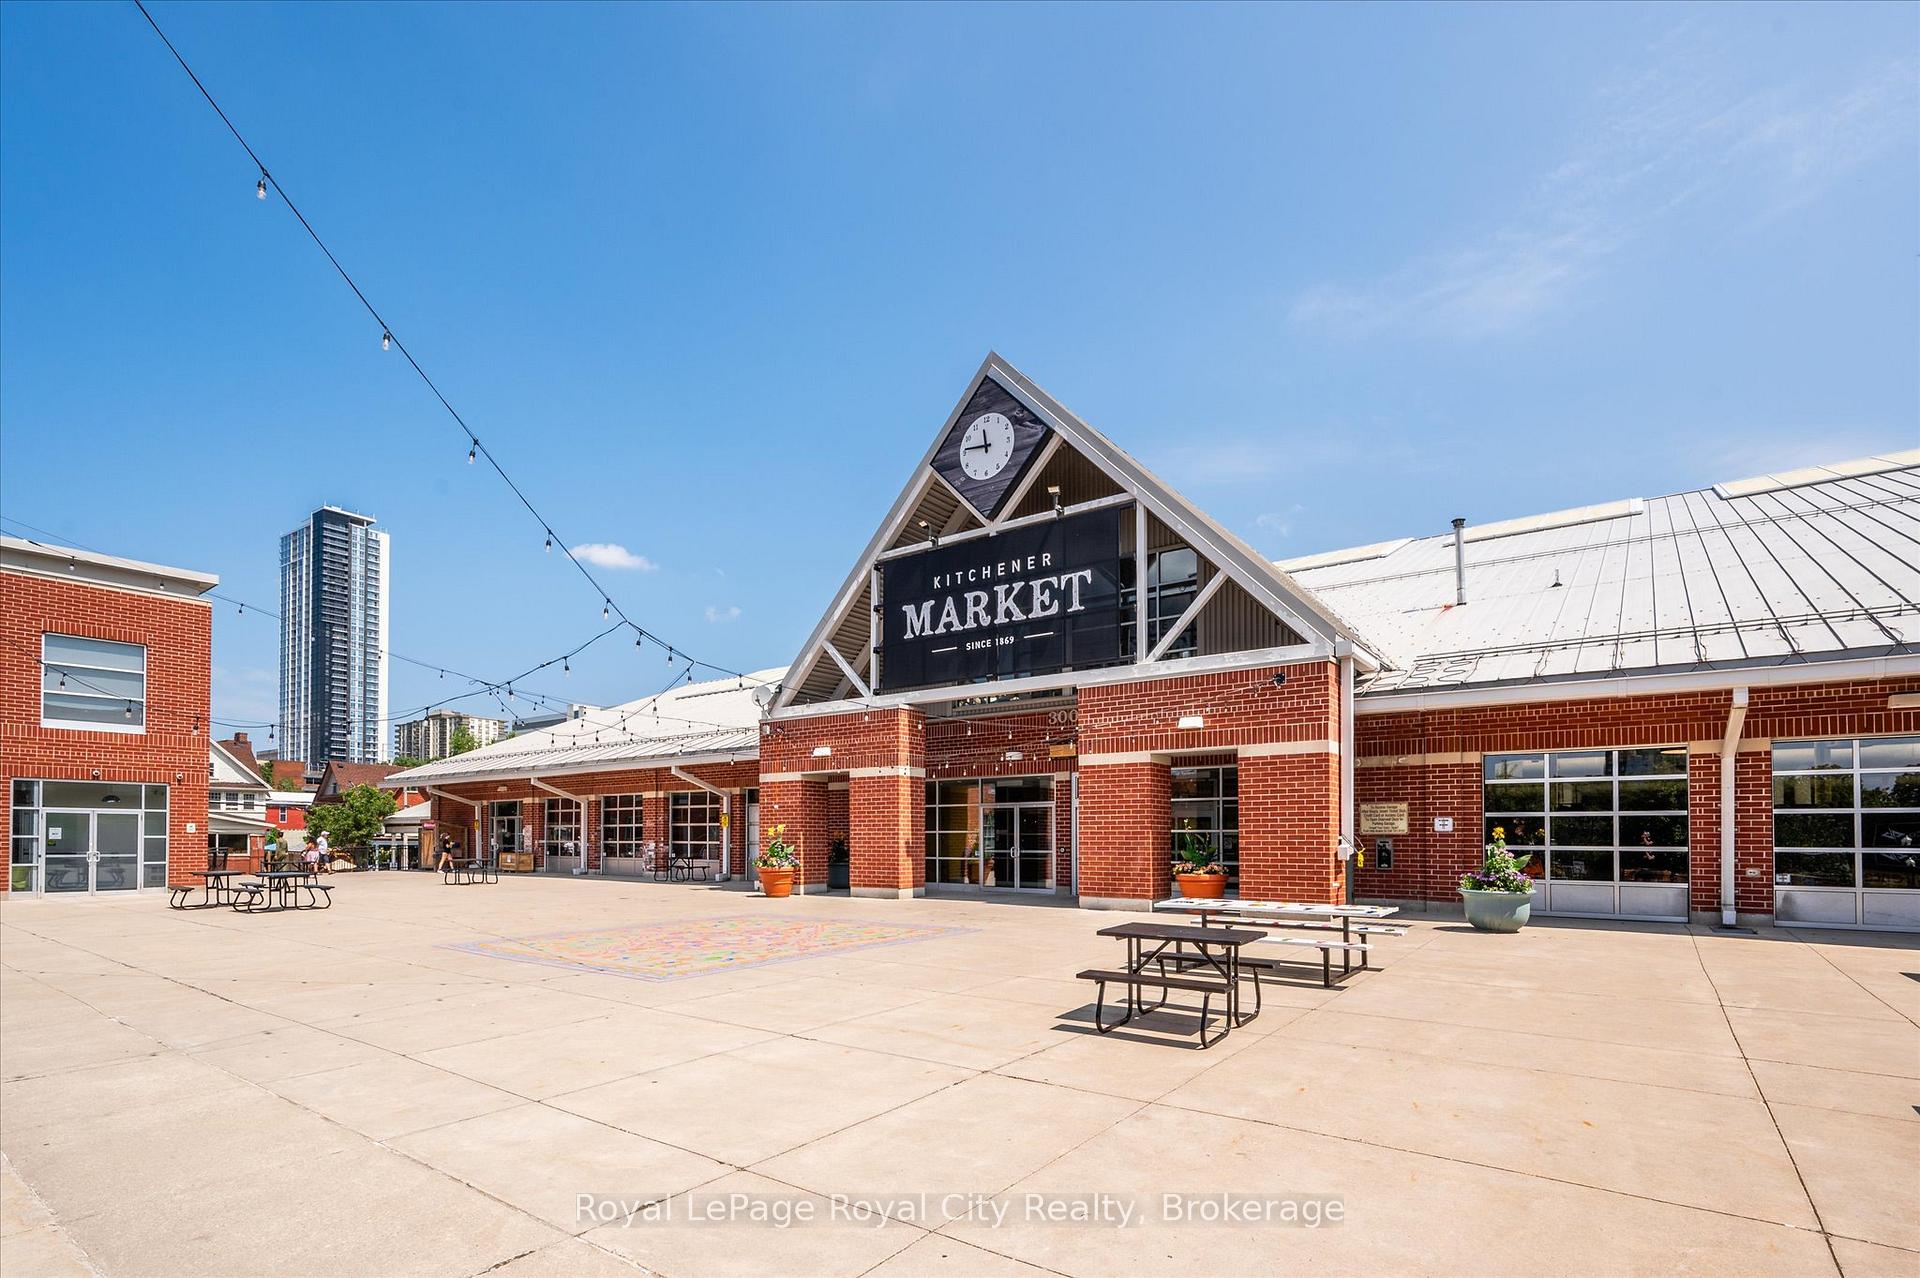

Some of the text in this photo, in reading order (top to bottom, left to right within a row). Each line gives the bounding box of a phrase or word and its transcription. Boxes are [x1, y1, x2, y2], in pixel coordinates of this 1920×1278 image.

[933, 553, 1052, 589] KITCHENER
[902, 569, 1092, 639] MARKET
[965, 635, 1015, 651] SINCE 1869
